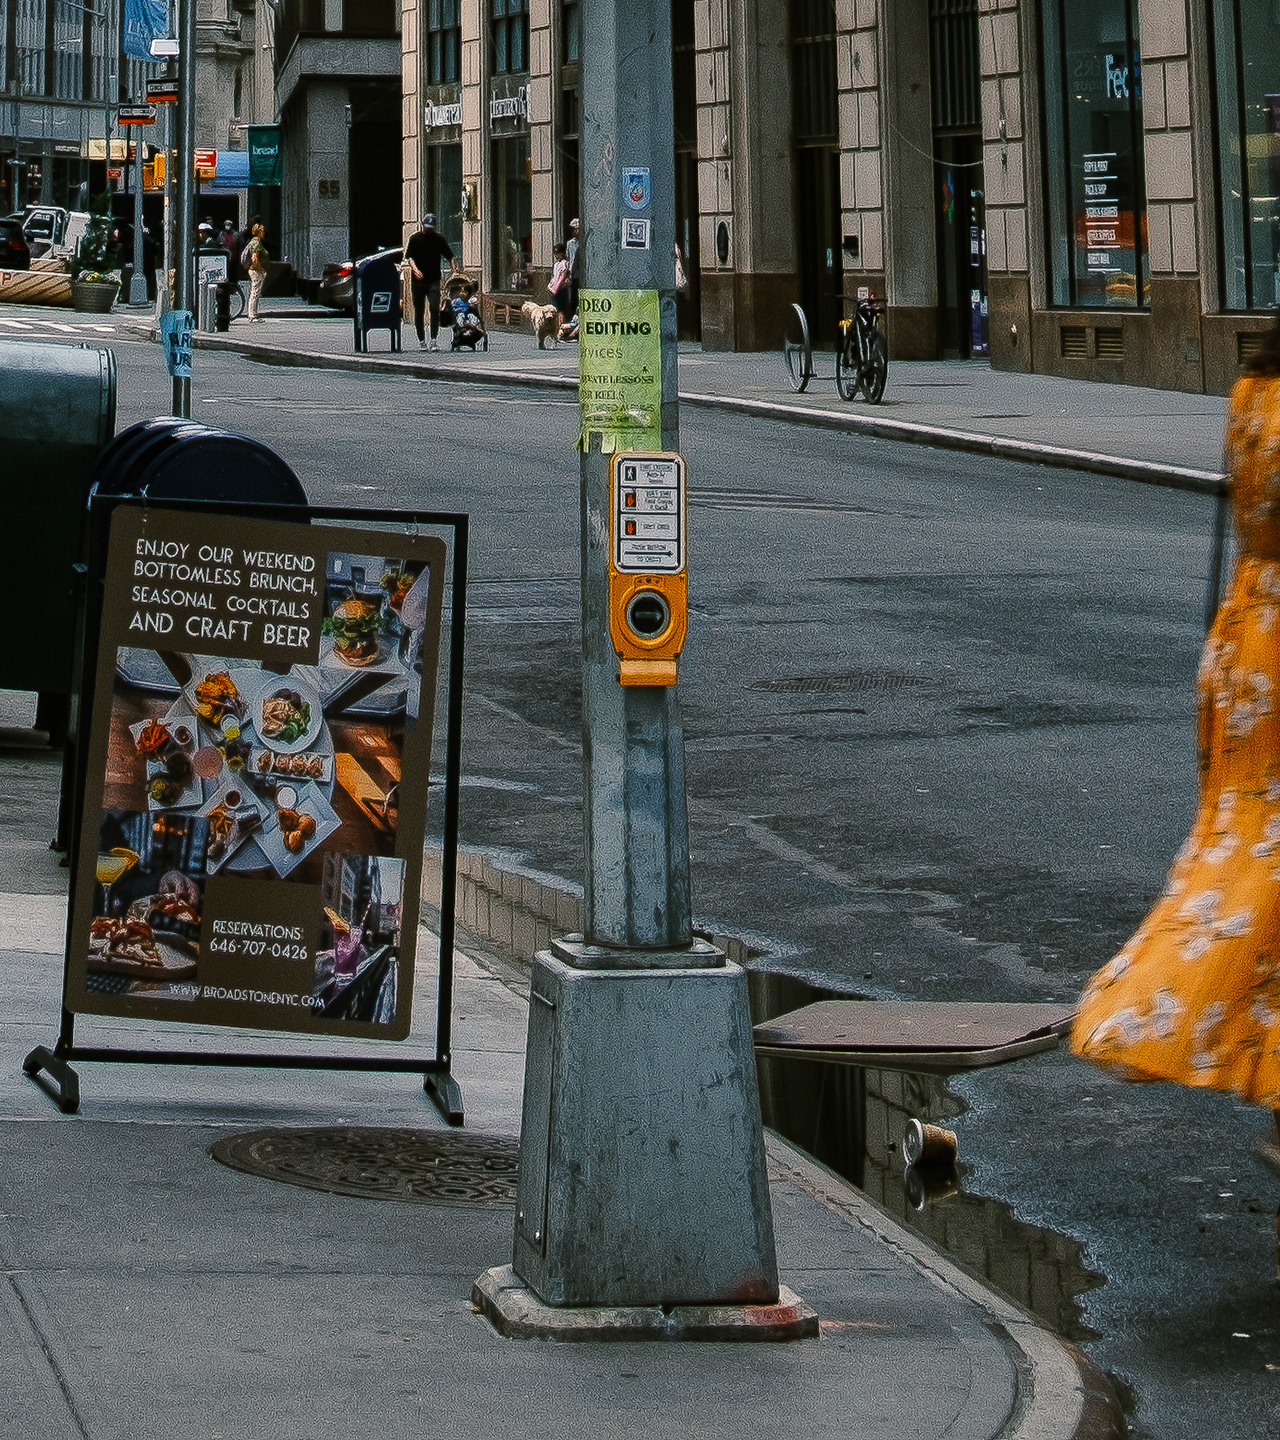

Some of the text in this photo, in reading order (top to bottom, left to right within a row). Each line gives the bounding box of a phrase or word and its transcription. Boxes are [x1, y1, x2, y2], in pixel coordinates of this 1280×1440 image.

[586, 322, 652, 335] EDITING
[136, 538, 315, 573] ENJOY OUR WEEKEND
[133, 559, 318, 597] BOTTOMLESS BRUNCH,
[131, 585, 310, 619] SEASONAL COCKTAILS
[128, 610, 311, 648] AND CRAFT BEER
[210, 937, 308, 960] 646-707-0426
